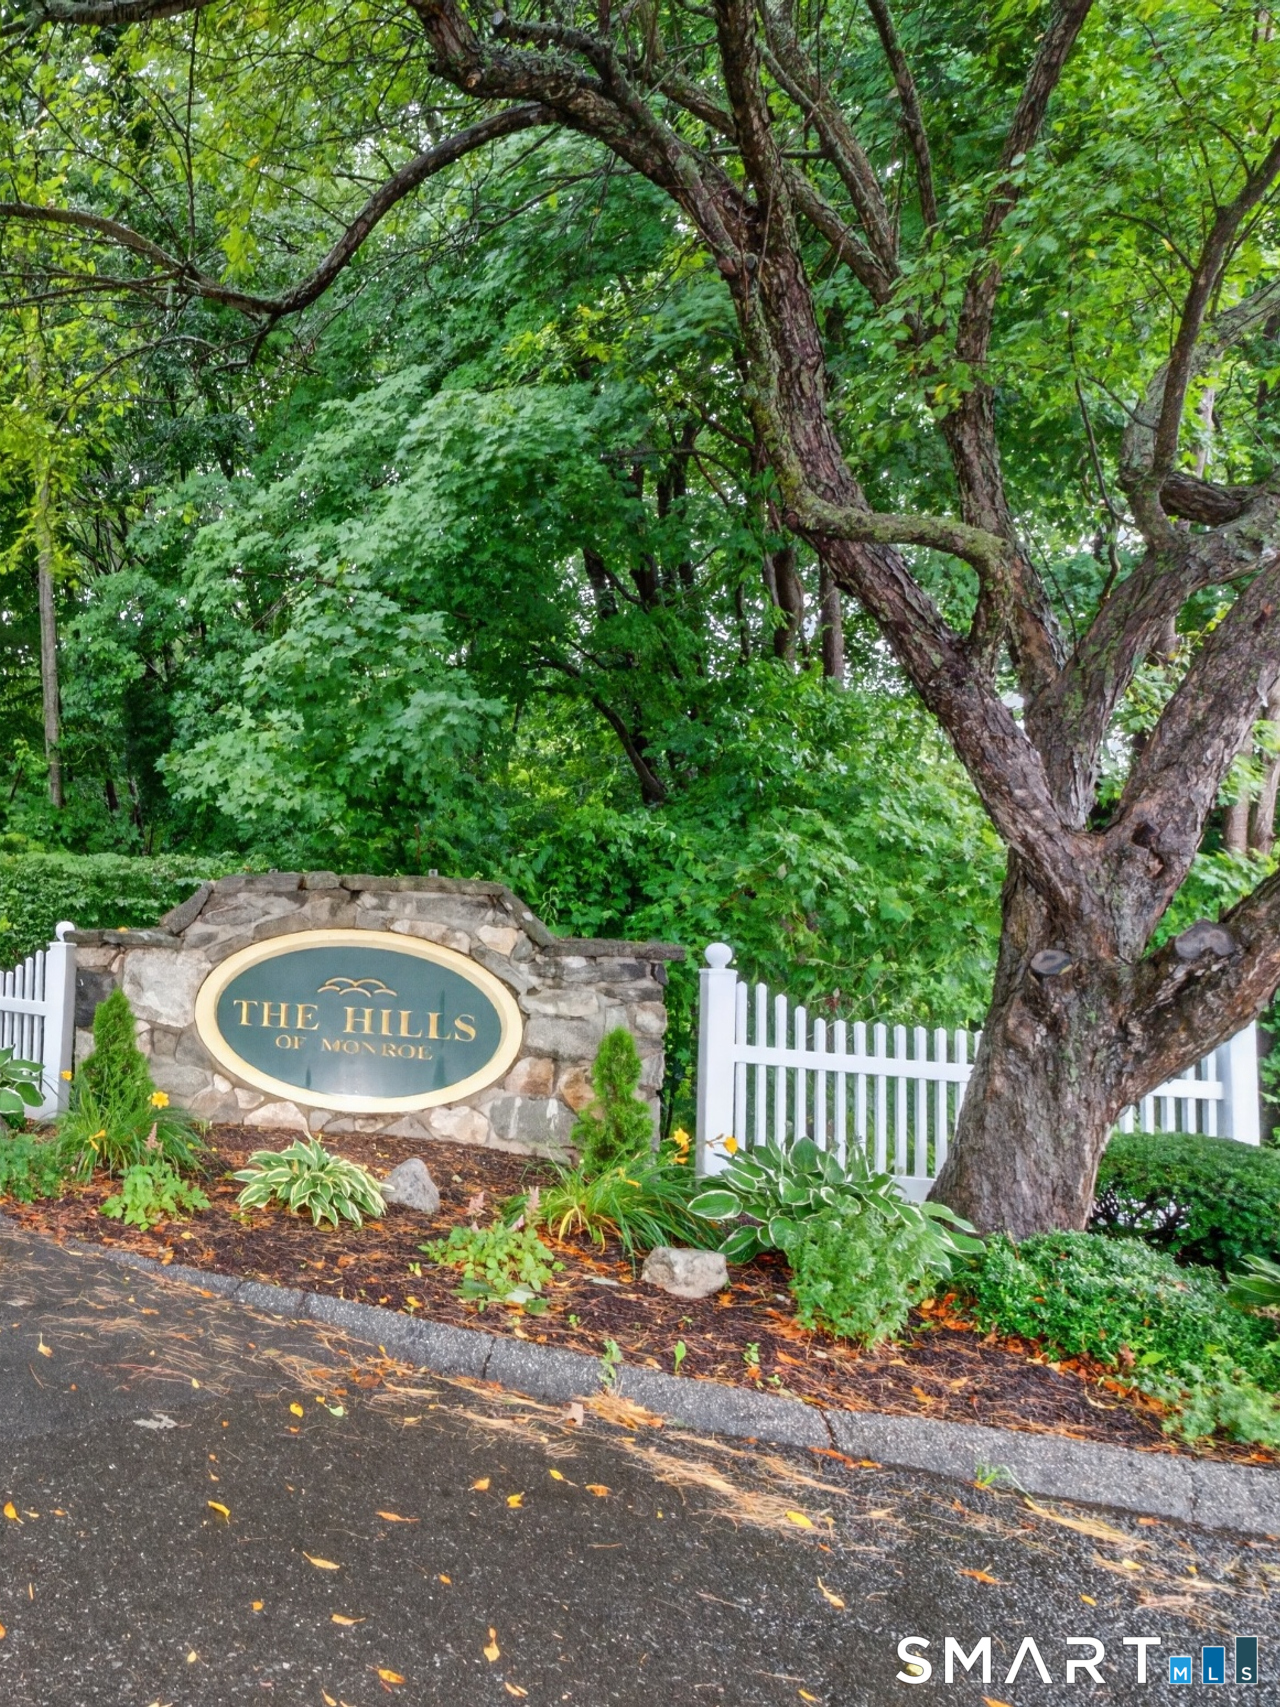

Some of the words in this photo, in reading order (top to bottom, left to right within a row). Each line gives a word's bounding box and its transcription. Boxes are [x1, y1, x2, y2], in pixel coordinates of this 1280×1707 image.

[233, 1000, 320, 1031] THE
[343, 1006, 477, 1042] HILLS
[275, 1034, 306, 1050] OF
[321, 1038, 433, 1061] MONROE
